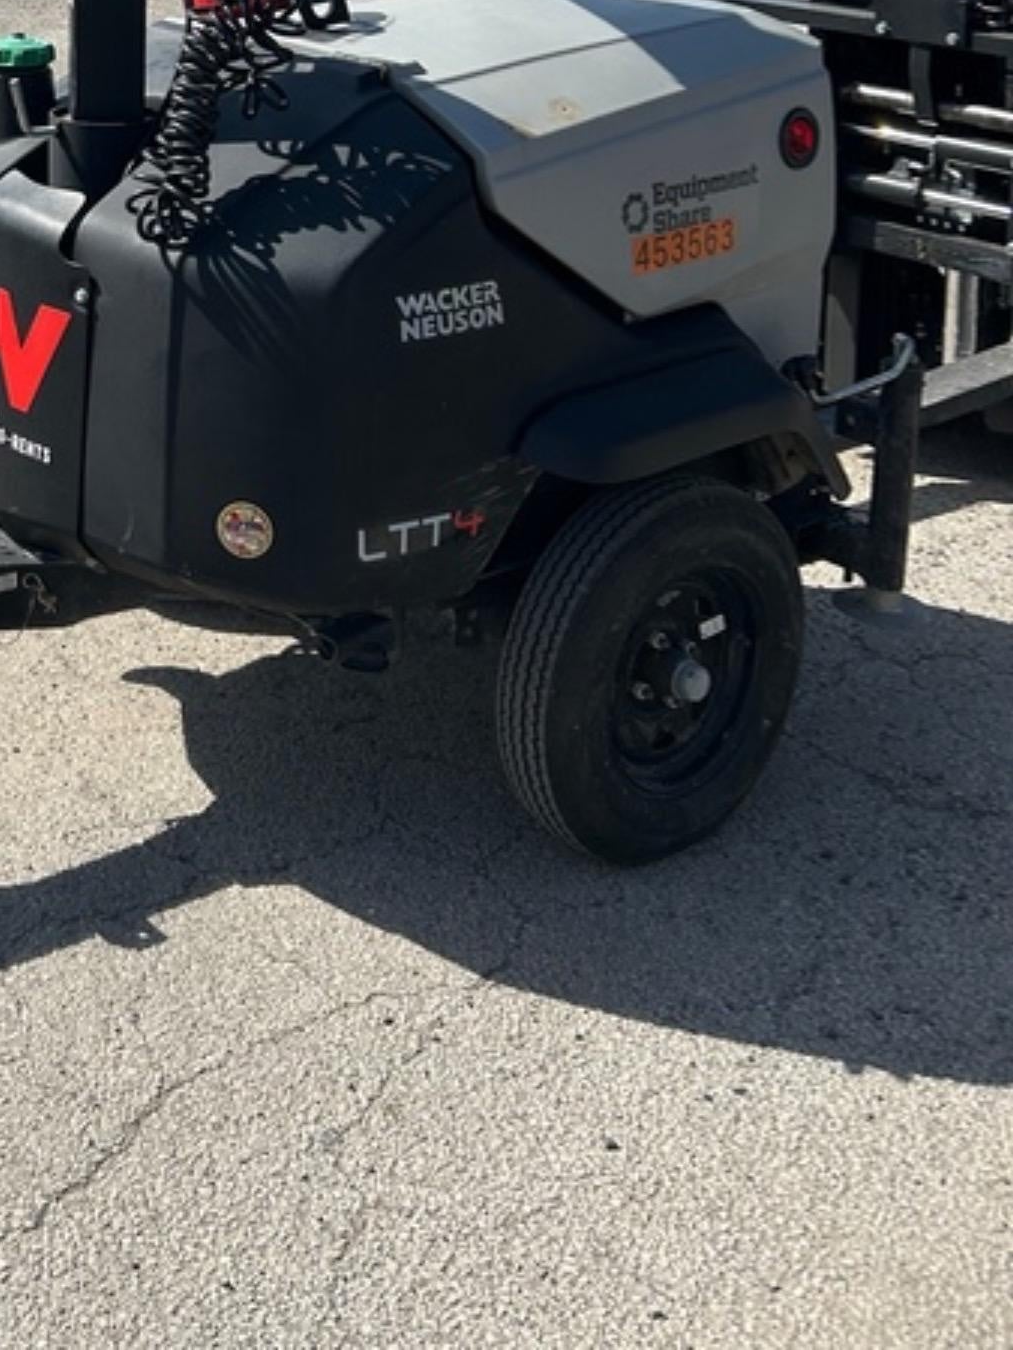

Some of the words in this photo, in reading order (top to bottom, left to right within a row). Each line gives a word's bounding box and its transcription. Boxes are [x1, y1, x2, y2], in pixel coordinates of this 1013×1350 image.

[652, 163, 759, 207] Equipment
[652, 206, 712, 234] Share
[635, 218, 733, 271] 453563
[395, 279, 501, 318] WACKER
[400, 302, 505, 343] NEUSON
[358, 511, 486, 562] LTT4
